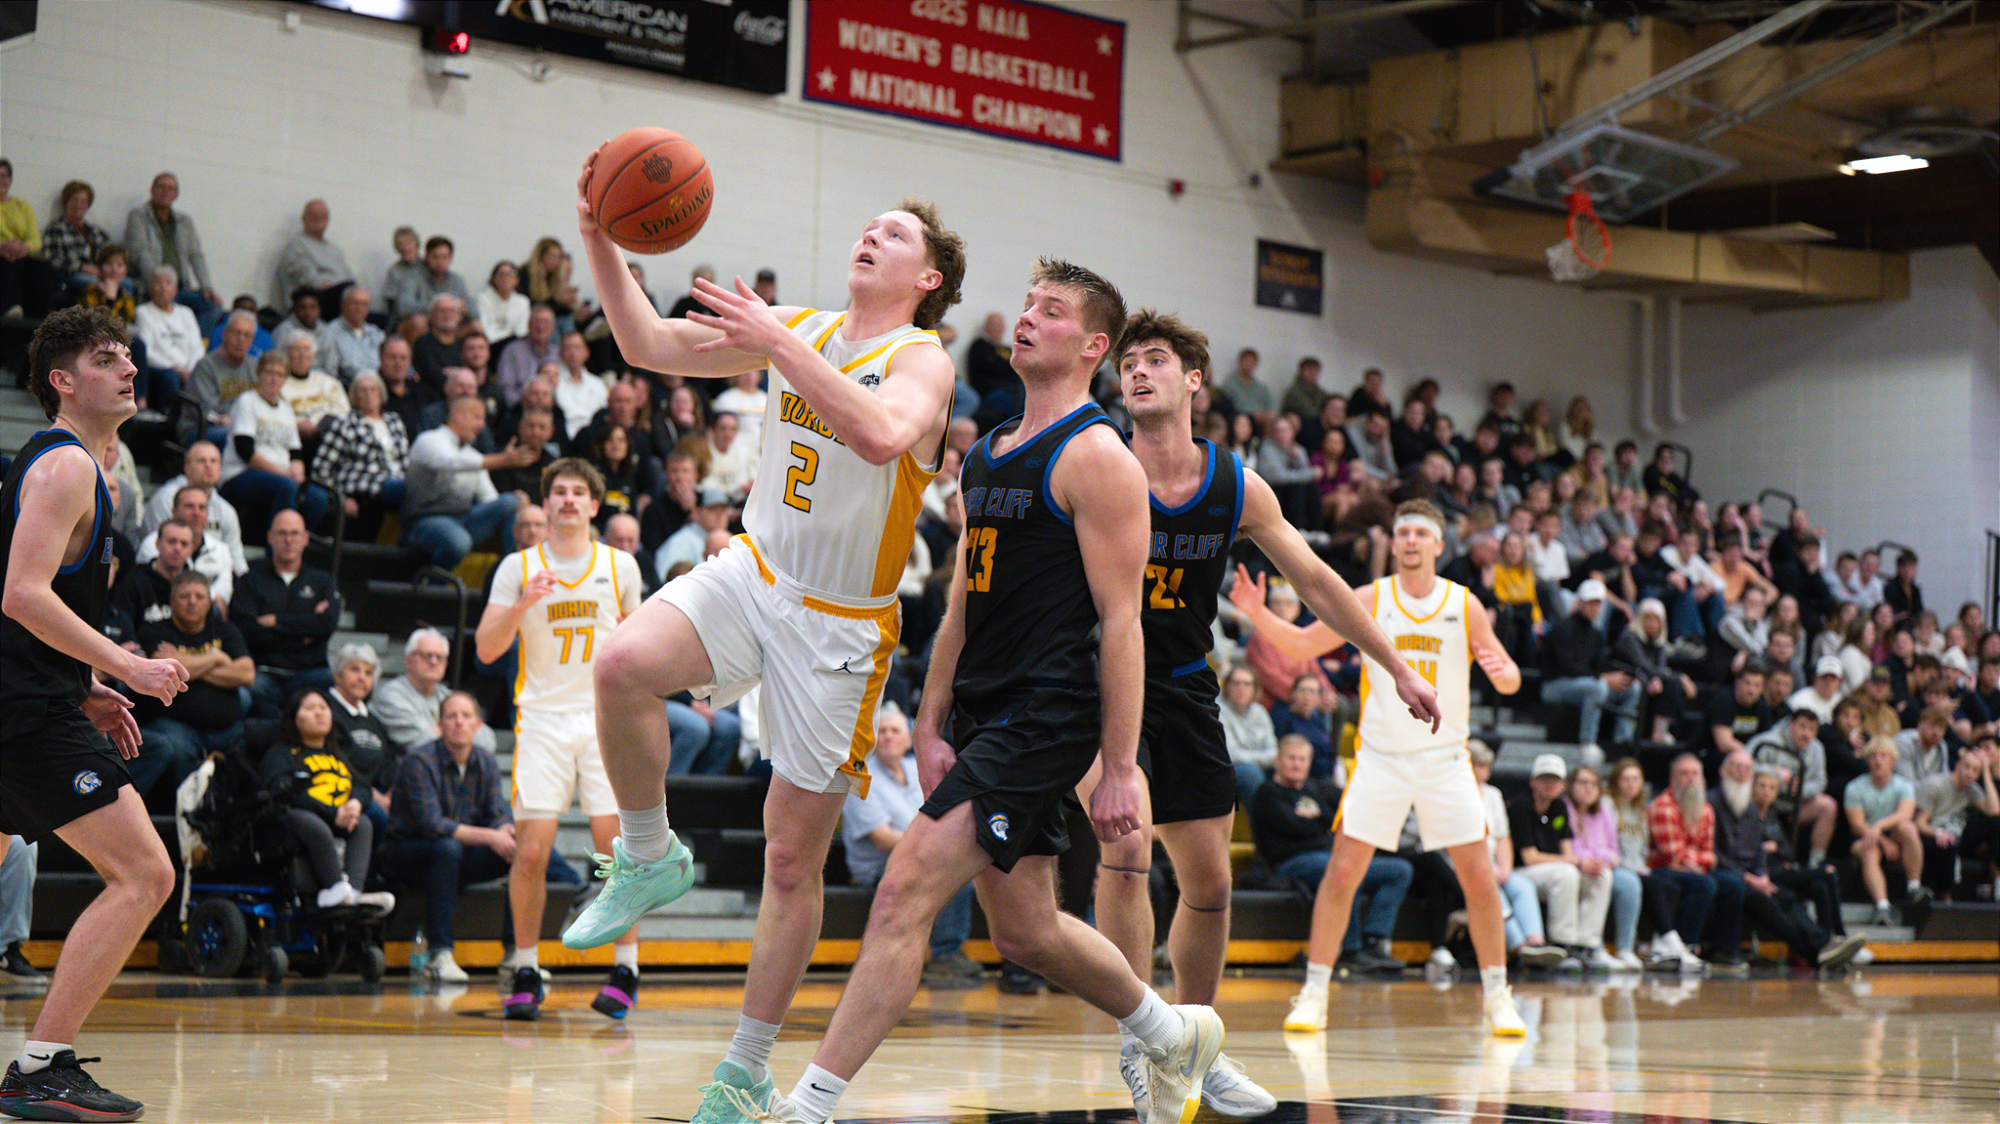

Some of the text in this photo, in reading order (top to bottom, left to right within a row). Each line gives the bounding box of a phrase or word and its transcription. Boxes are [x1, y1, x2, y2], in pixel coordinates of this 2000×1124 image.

[977, 3, 1030, 41] NAIA
[838, 18, 1095, 100] WOMEN'S BASKETBALL
[849, 68, 1082, 143] NATIONAL CHAMPION
[641, 181, 711, 238] SPALDING
[783, 440, 819, 514] 2
[984, 487, 1033, 519] CLIFF
[1173, 533, 1225, 560] CLIFF
[1144, 563, 1187, 609] 21
[547, 600, 599, 623] DORDT
[553, 626, 594, 664] 77
